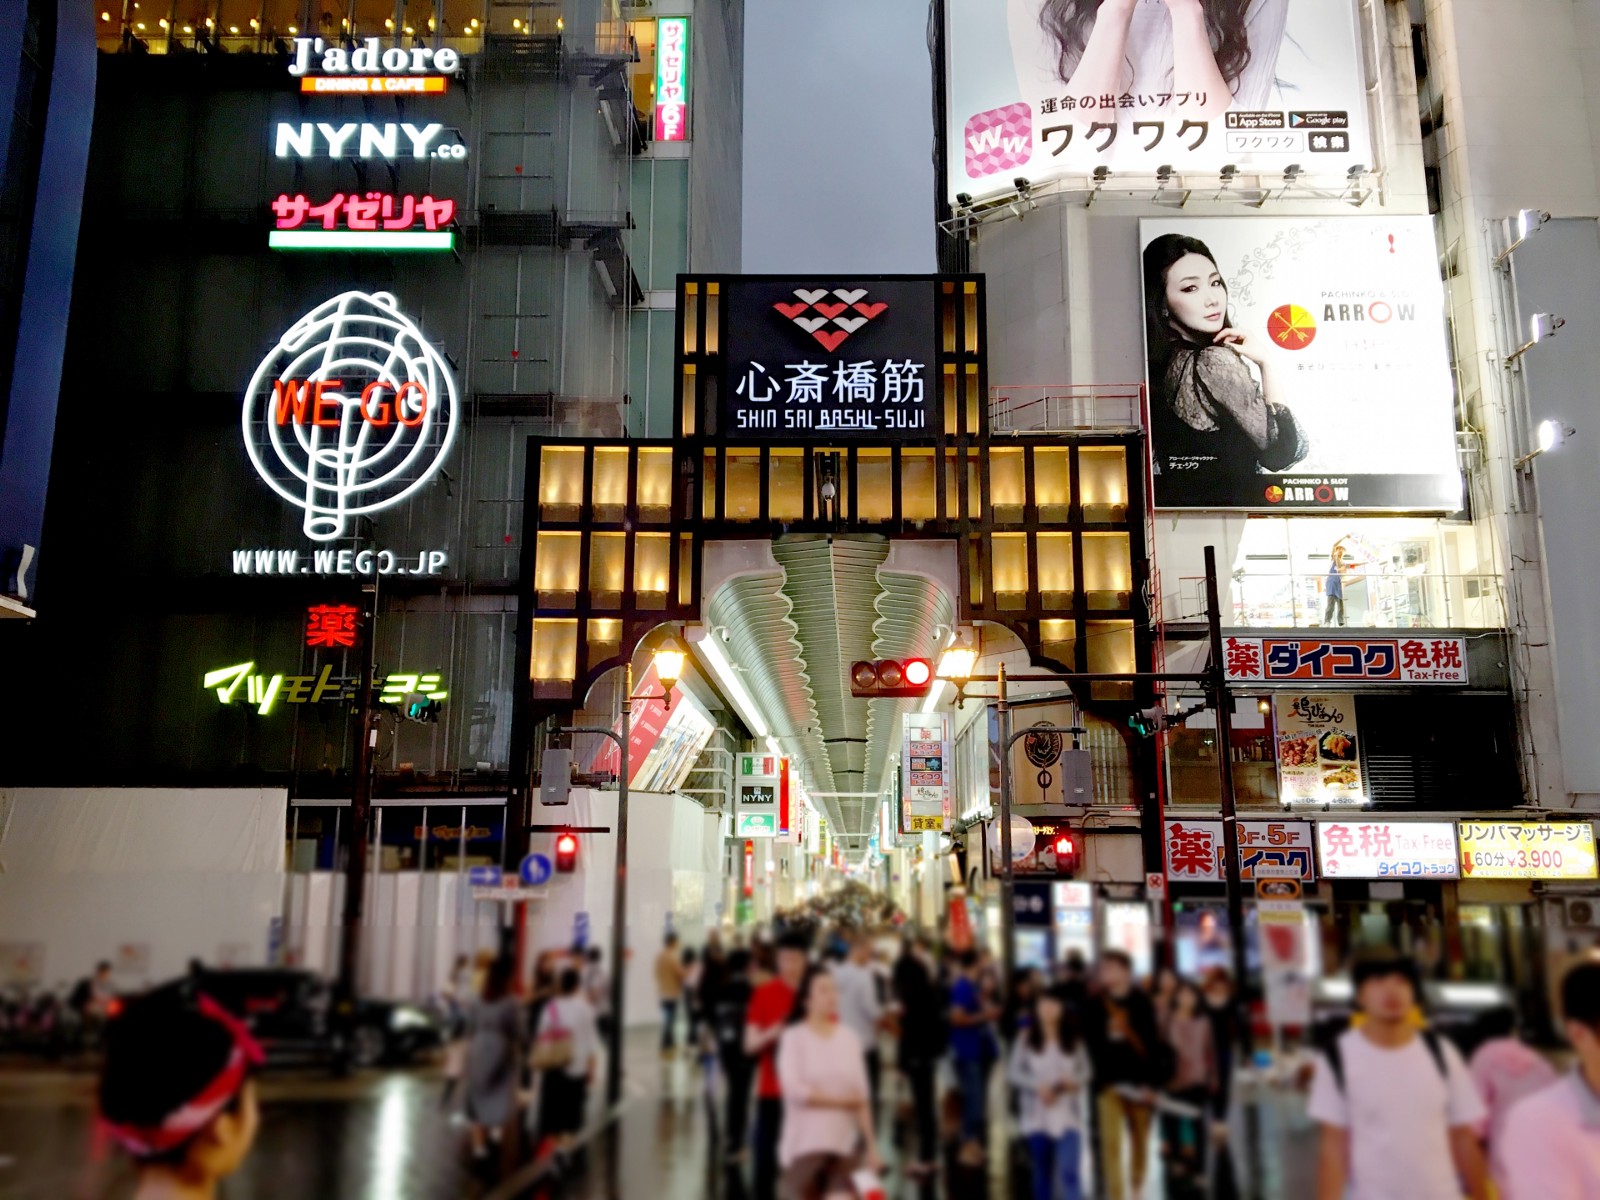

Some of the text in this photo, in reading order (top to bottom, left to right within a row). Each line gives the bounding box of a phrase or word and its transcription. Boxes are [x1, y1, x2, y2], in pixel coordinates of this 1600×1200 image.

[288, 37, 458, 75] J'adore
[314, 78, 426, 91] DINING & CAFE
[1040, 92, 1208, 115] 運命の出会いアプリ
[1239, 117, 1282, 128] App Store
[1306, 117, 1346, 126] Google play
[275, 122, 466, 158] NYNY.co
[1041, 119, 1209, 157] ワクワク
[1235, 136, 1294, 148] ワクワク
[272, 192, 453, 230] サイゼリヤ
[1323, 301, 1415, 324] ARROW
[735, 358, 926, 404] 心斎橋筋
[273, 380, 428, 427] WE GO
[737, 409, 777, 428] SHIN
[784, 409, 813, 428] SAI
[1284, 484, 1349, 503] ARROW
[232, 550, 446, 574] WWW.WEGO.JP
[306, 604, 358, 647] 薬
[1226, 637, 1462, 679] 薬 ダイコク 免税
[1408, 669, 1459, 680] Tax-Free
[742, 794, 772, 802] NYNY
[1323, 824, 1394, 857] 免税
[1460, 825, 1581, 841] リンパマッサージ
[1169, 823, 1214, 875] 薬
[1475, 852, 1505, 867] 60分
